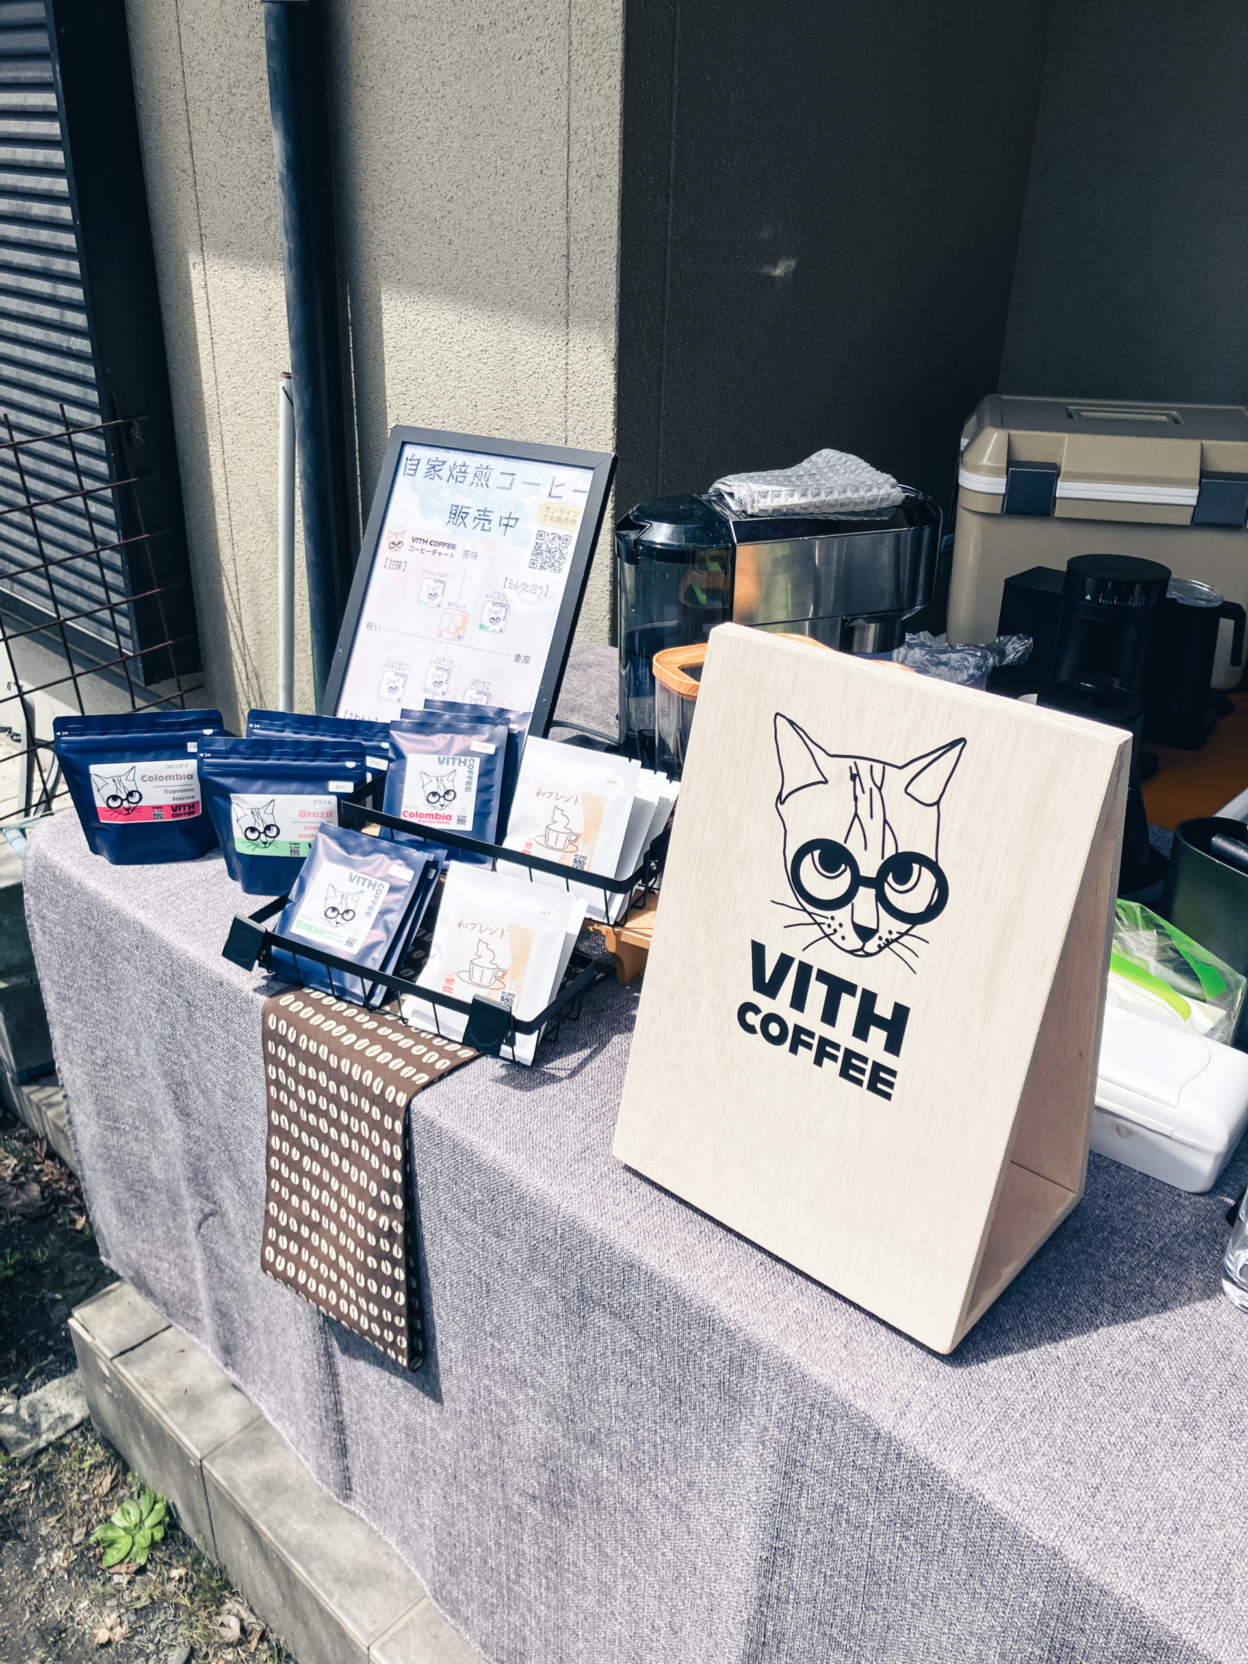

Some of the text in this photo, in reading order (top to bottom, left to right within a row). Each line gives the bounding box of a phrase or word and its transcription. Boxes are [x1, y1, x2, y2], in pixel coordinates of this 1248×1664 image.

[403, 454, 588, 499] 自家焙煎コーヒー
[545, 506, 580, 517] オンライン
[446, 503, 520, 537] 販売中
[543, 514, 578, 526] でも販売中
[411, 537, 457, 550] VITH COFFEE
[408, 545, 455, 559] コーヒーチャート
[462, 550, 478, 560] 苦味
[437, 756, 468, 767] VITH
[141, 773, 194, 782] Colombia
[464, 758, 475, 793] COFFEE
[535, 788, 582, 805] 和ブレンド
[171, 803, 195, 812] VITH
[299, 810, 333, 818] Brazil
[402, 810, 453, 821] Colombia
[348, 872, 378, 890] VITH
[364, 883, 384, 918] COFFEE
[294, 919, 326, 936] Brazil
[457, 919, 508, 938] 和ブレンド
[751, 939, 911, 1058] VITH
[737, 1001, 898, 1102] COFFEE
